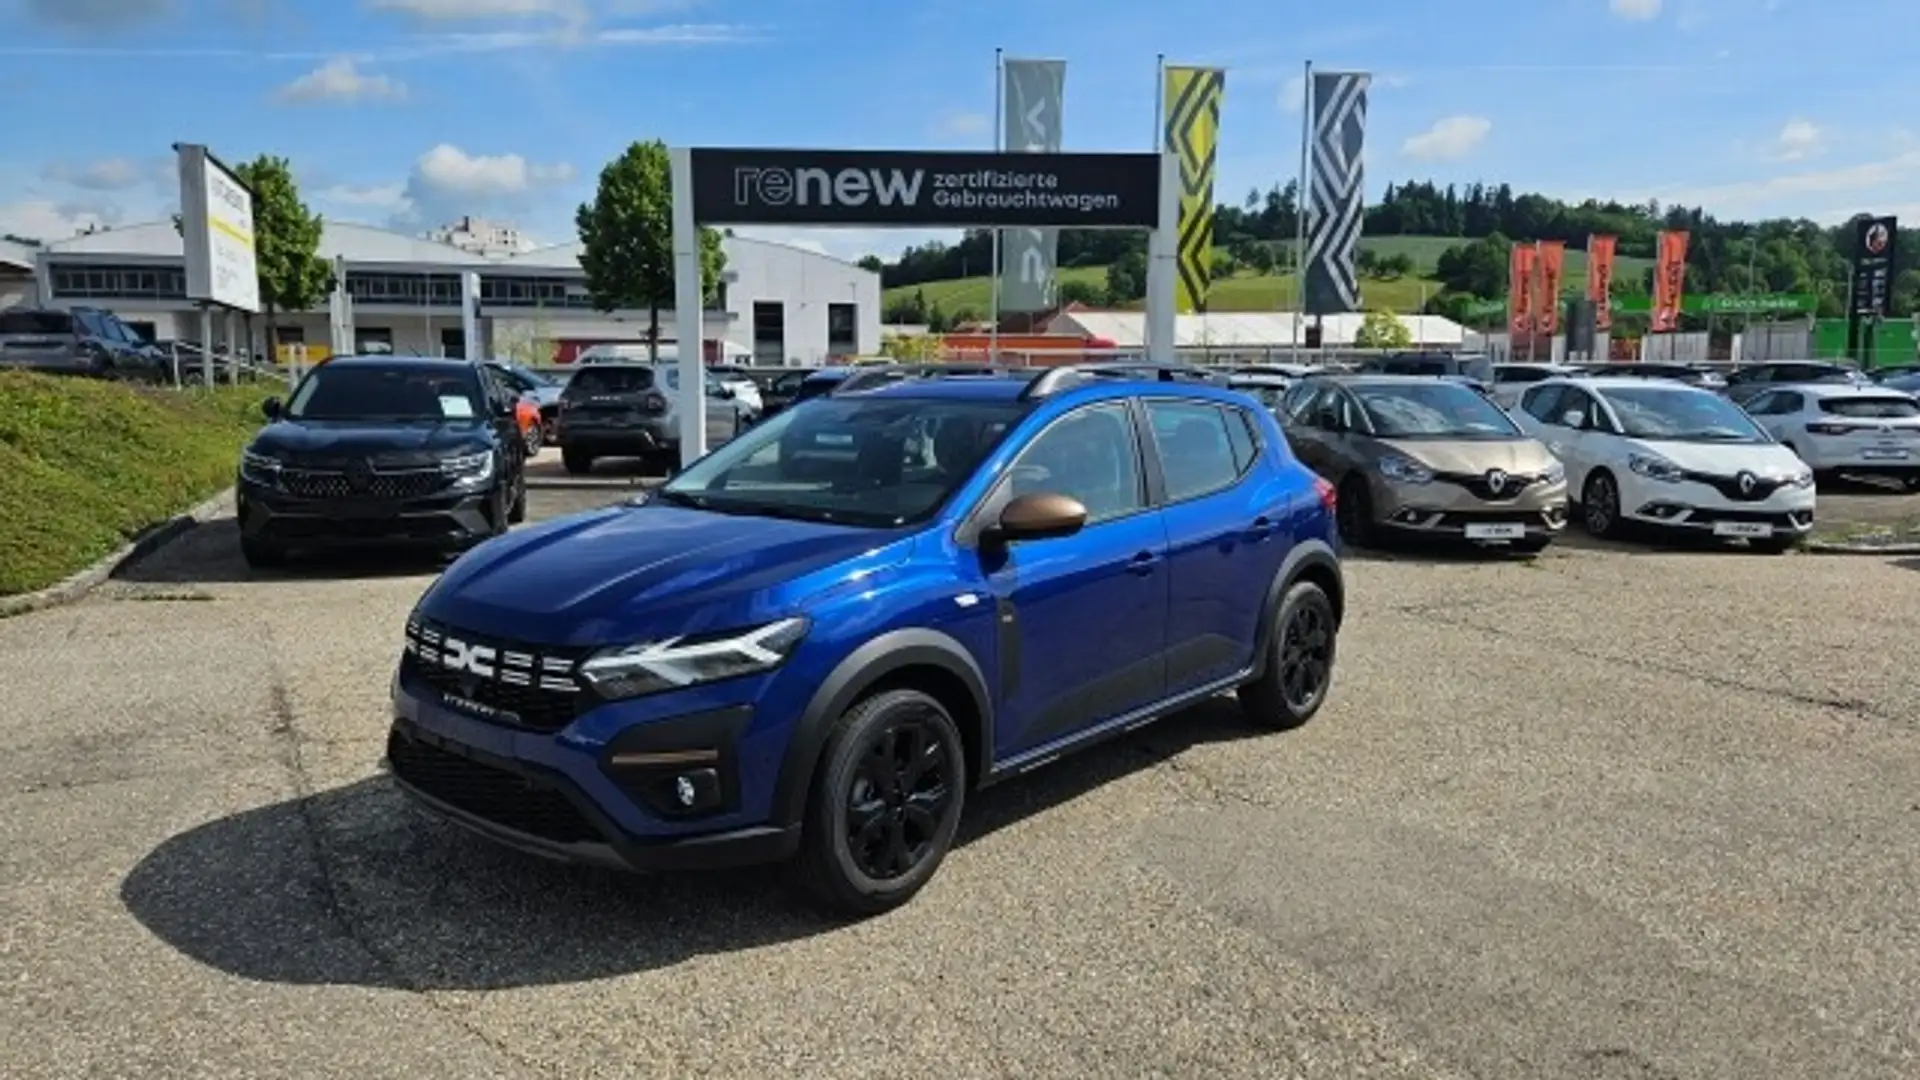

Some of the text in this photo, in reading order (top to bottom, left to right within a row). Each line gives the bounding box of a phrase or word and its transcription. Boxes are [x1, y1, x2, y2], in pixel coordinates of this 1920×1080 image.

[734, 166, 924, 206] renew
[933, 170, 1058, 189] zertifizierte
[933, 190, 1118, 211] Gebrauchtwagen
